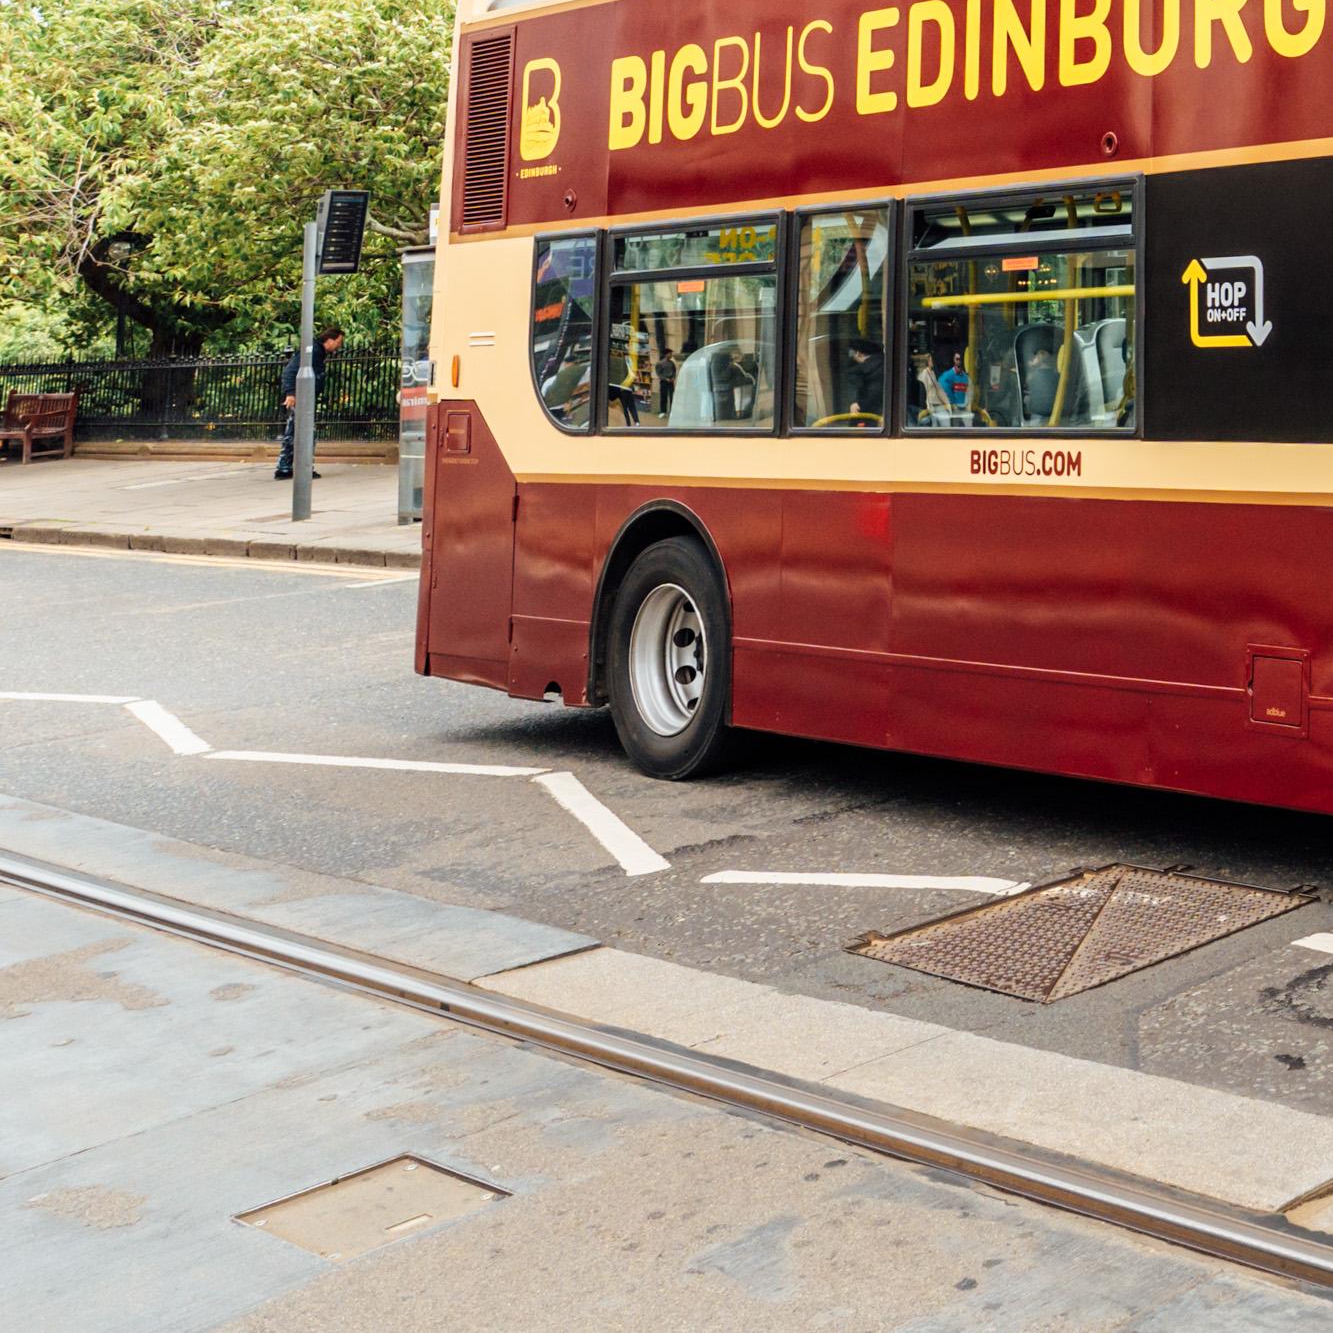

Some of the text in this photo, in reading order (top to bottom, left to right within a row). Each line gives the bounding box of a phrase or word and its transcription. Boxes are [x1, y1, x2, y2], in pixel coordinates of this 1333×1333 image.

[520, 165, 558, 179] EDINBURGH
[1206, 282, 1247, 307] HOP
[1206, 308, 1247, 322] ON+OFF
[970, 450, 1082, 476] BIGBUS.COM
